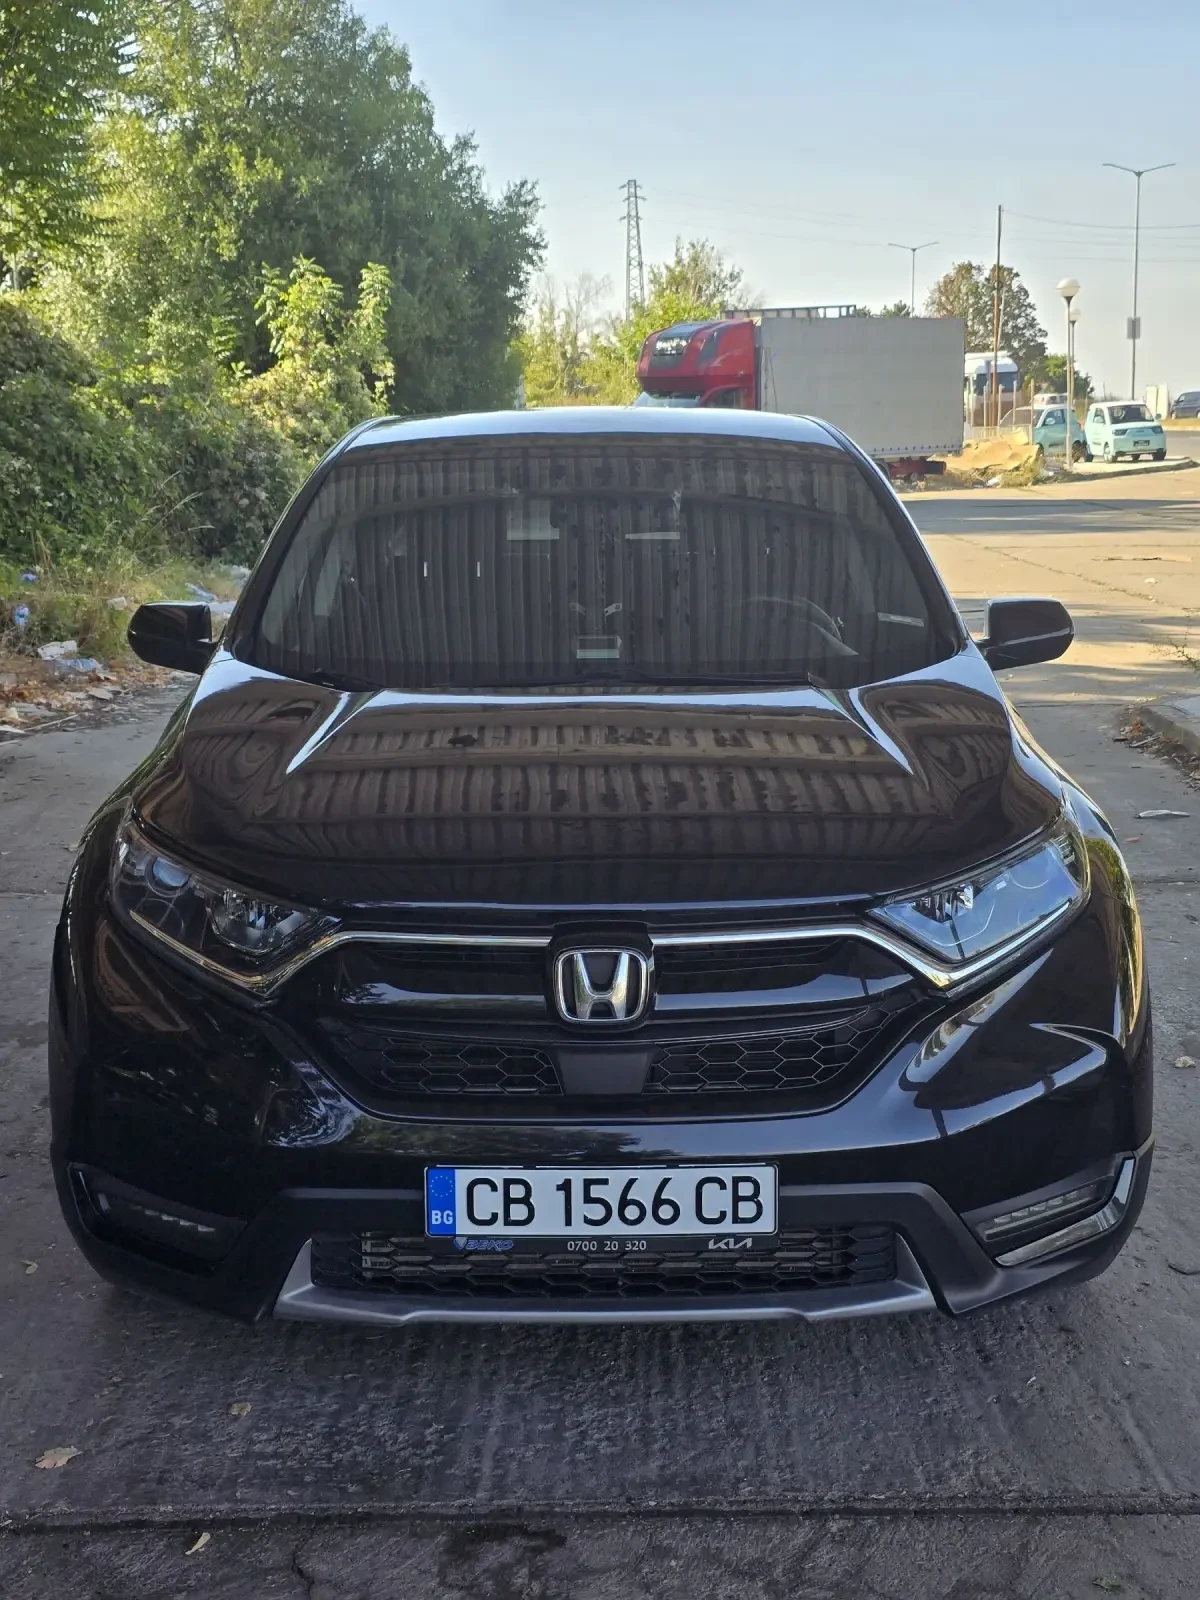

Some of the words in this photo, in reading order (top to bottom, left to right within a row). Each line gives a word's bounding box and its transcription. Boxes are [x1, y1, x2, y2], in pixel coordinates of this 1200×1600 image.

[466, 1177, 535, 1226] CB
[555, 1177, 681, 1226] 1566
[694, 1176, 764, 1225] CB
[431, 1210, 453, 1225] BG
[567, 1240, 598, 1251] 0700
[603, 1240, 619, 1251] 20
[624, 1240, 647, 1251] 320
[708, 1237, 753, 1250] KIA
